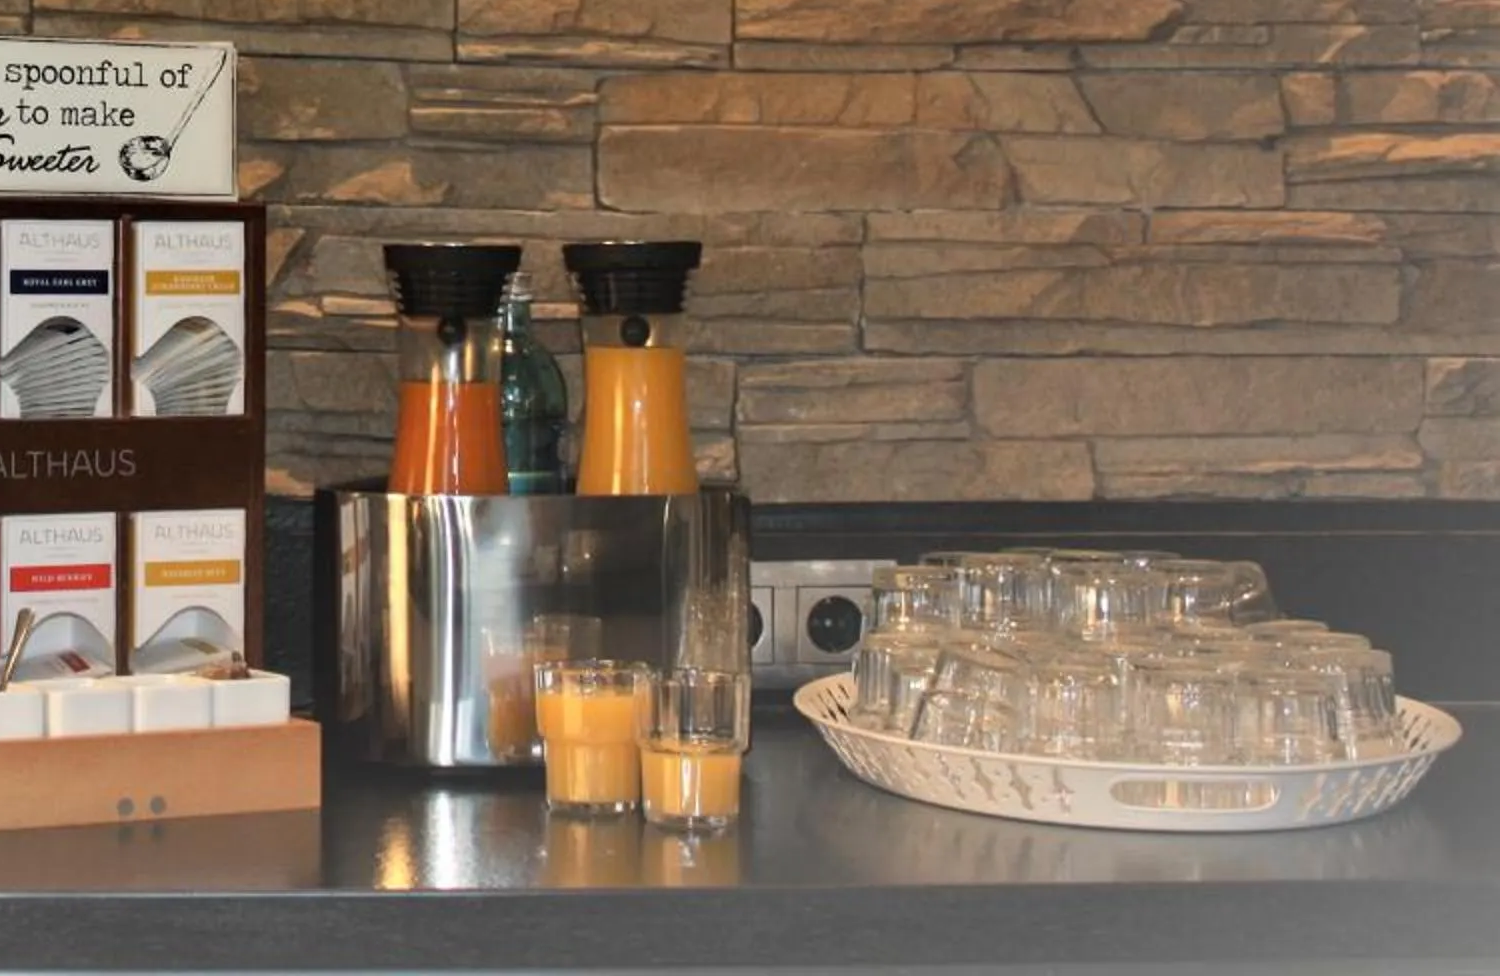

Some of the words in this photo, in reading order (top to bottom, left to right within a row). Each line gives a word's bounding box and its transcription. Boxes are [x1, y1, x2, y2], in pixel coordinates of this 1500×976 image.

[4, 59, 148, 91] spoonful
[160, 63, 193, 89] of
[16, 98, 50, 125] to
[60, 101, 135, 127] make
[19, 231, 100, 250] ALTHAUS
[153, 232, 233, 251] ALTHAUS
[19, 527, 105, 545] ALTHAUS
[154, 523, 235, 540] ALTHAUS
